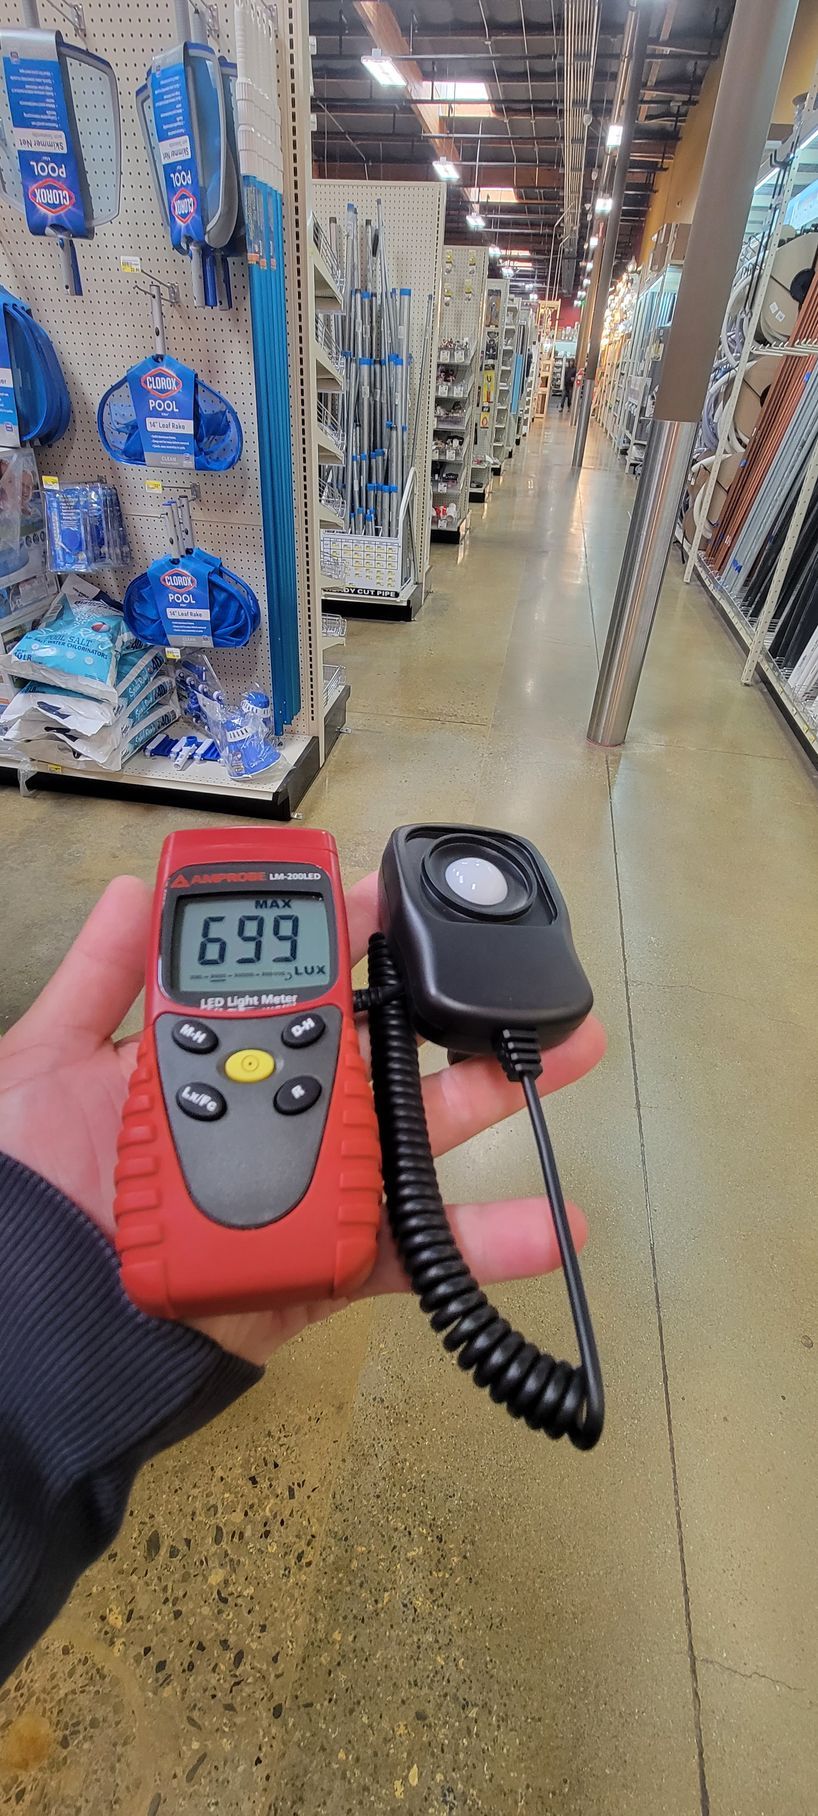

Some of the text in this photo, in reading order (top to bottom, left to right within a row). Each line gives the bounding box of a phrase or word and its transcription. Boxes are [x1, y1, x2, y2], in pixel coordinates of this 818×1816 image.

[19, 139, 64, 151] Skimmer Net
[30, 161, 66, 178] POOL
[170, 170, 192, 188] POOL
[35, 188, 69, 206] CLOROX
[146, 376, 178, 391] CLOROX
[149, 399, 179, 412] POOL
[172, 422, 186, 431] Rake
[165, 575, 193, 587] CLOROX
[168, 594, 196, 604] POOL
[67, 635, 92, 647] SALT
[66, 642, 108, 660] CHLORINATORS
[190, 872, 321, 884] AMPROBE LM-200LED
[255, 899, 292, 910] MAX
[198, 914, 299, 965] 699
[294, 965, 326, 976] LUX
[200, 994, 298, 1010] LED Light Meter
[290, 1017, 315, 1037] D-H
[181, 1084, 305, 1112] Lx/Fc R
